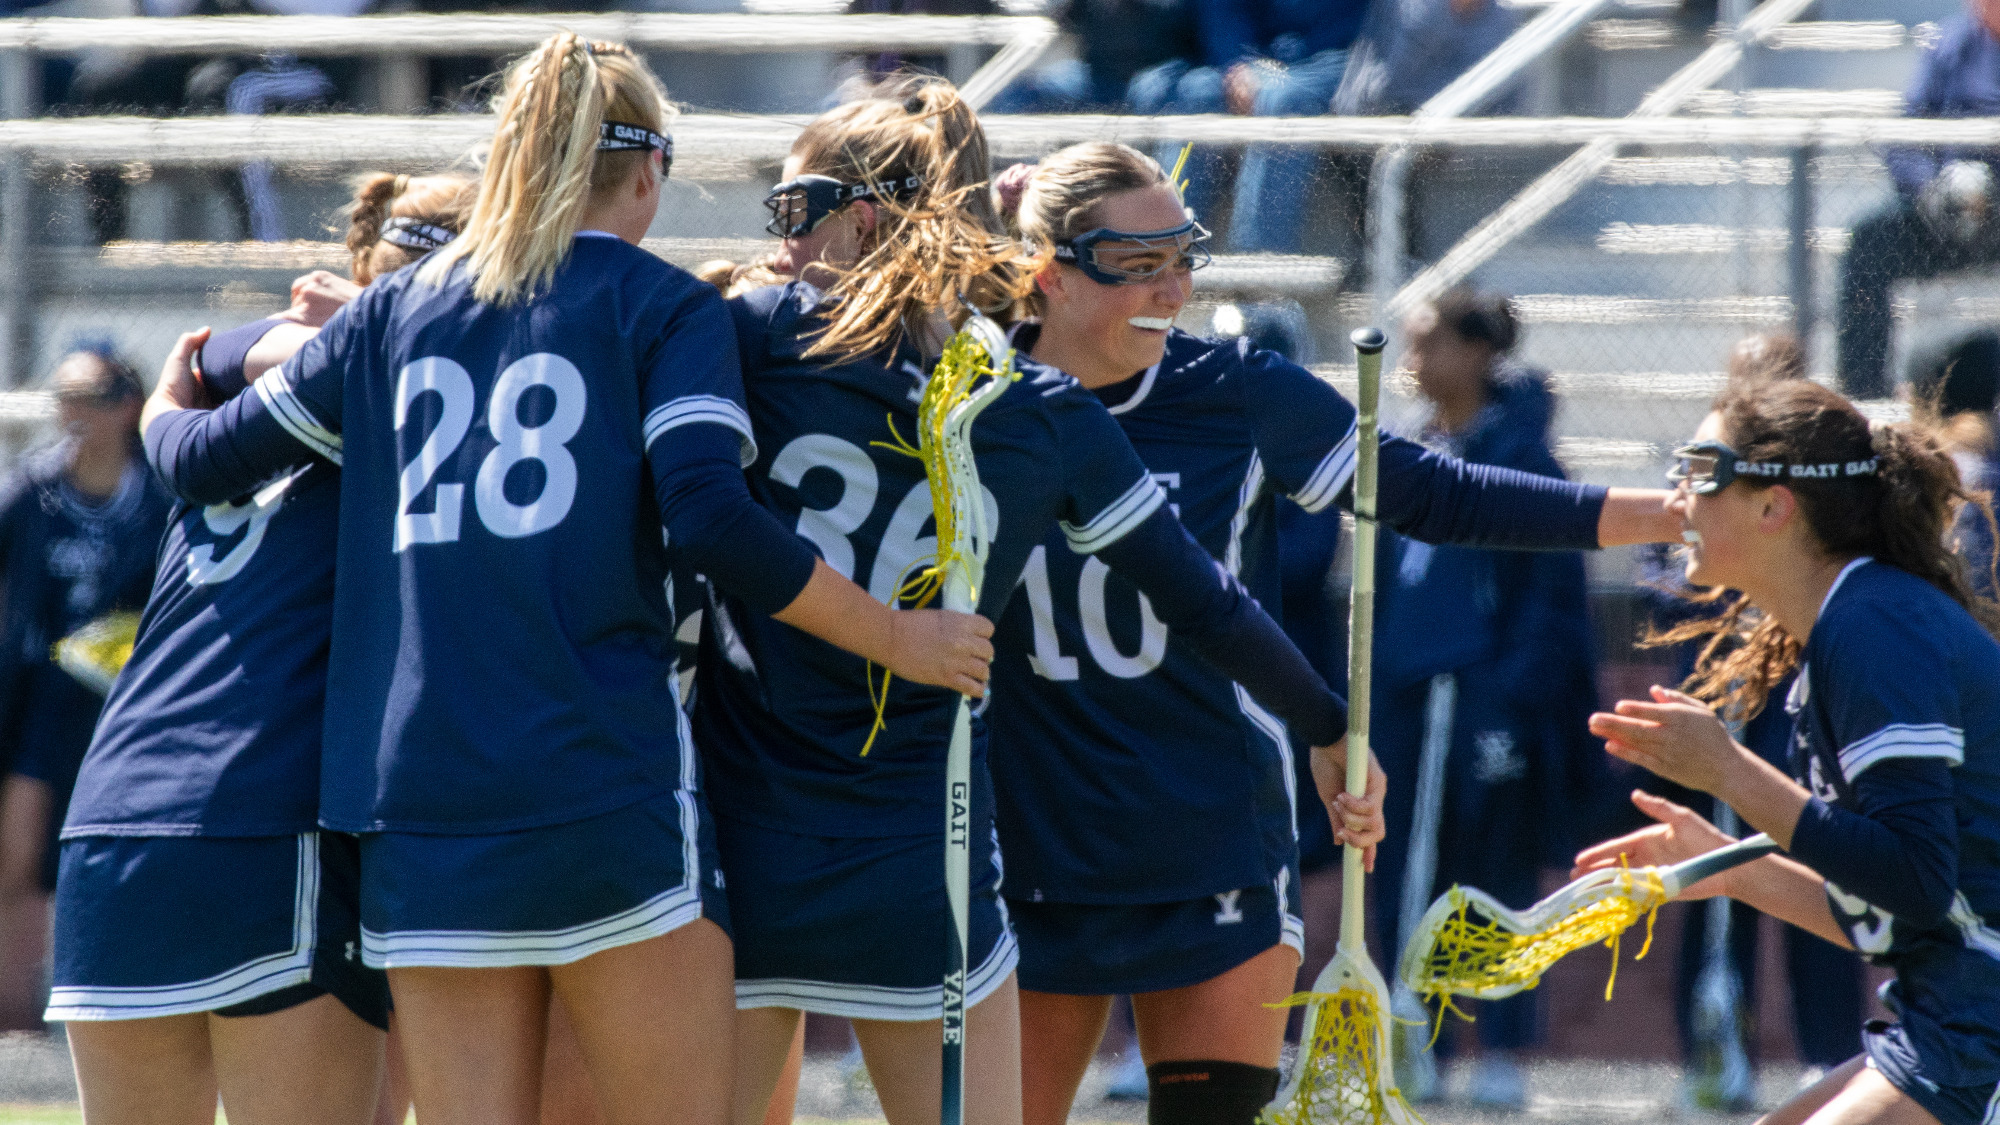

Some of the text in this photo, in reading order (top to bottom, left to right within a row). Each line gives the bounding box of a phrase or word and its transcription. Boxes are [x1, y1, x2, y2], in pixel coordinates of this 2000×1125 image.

[614, 125, 647, 142] GAIT
[1056, 245, 1075, 258] GA
[392, 352, 587, 553] 28
[1734, 460, 1783, 476] GAIT
[1790, 464, 1839, 478] GAIT
[769, 434, 998, 611] 36
[1011, 544, 1168, 681] 10
[951, 782, 967, 849] GAIT
[1214, 889, 1243, 925] Y
[943, 969, 963, 1045] YALE
